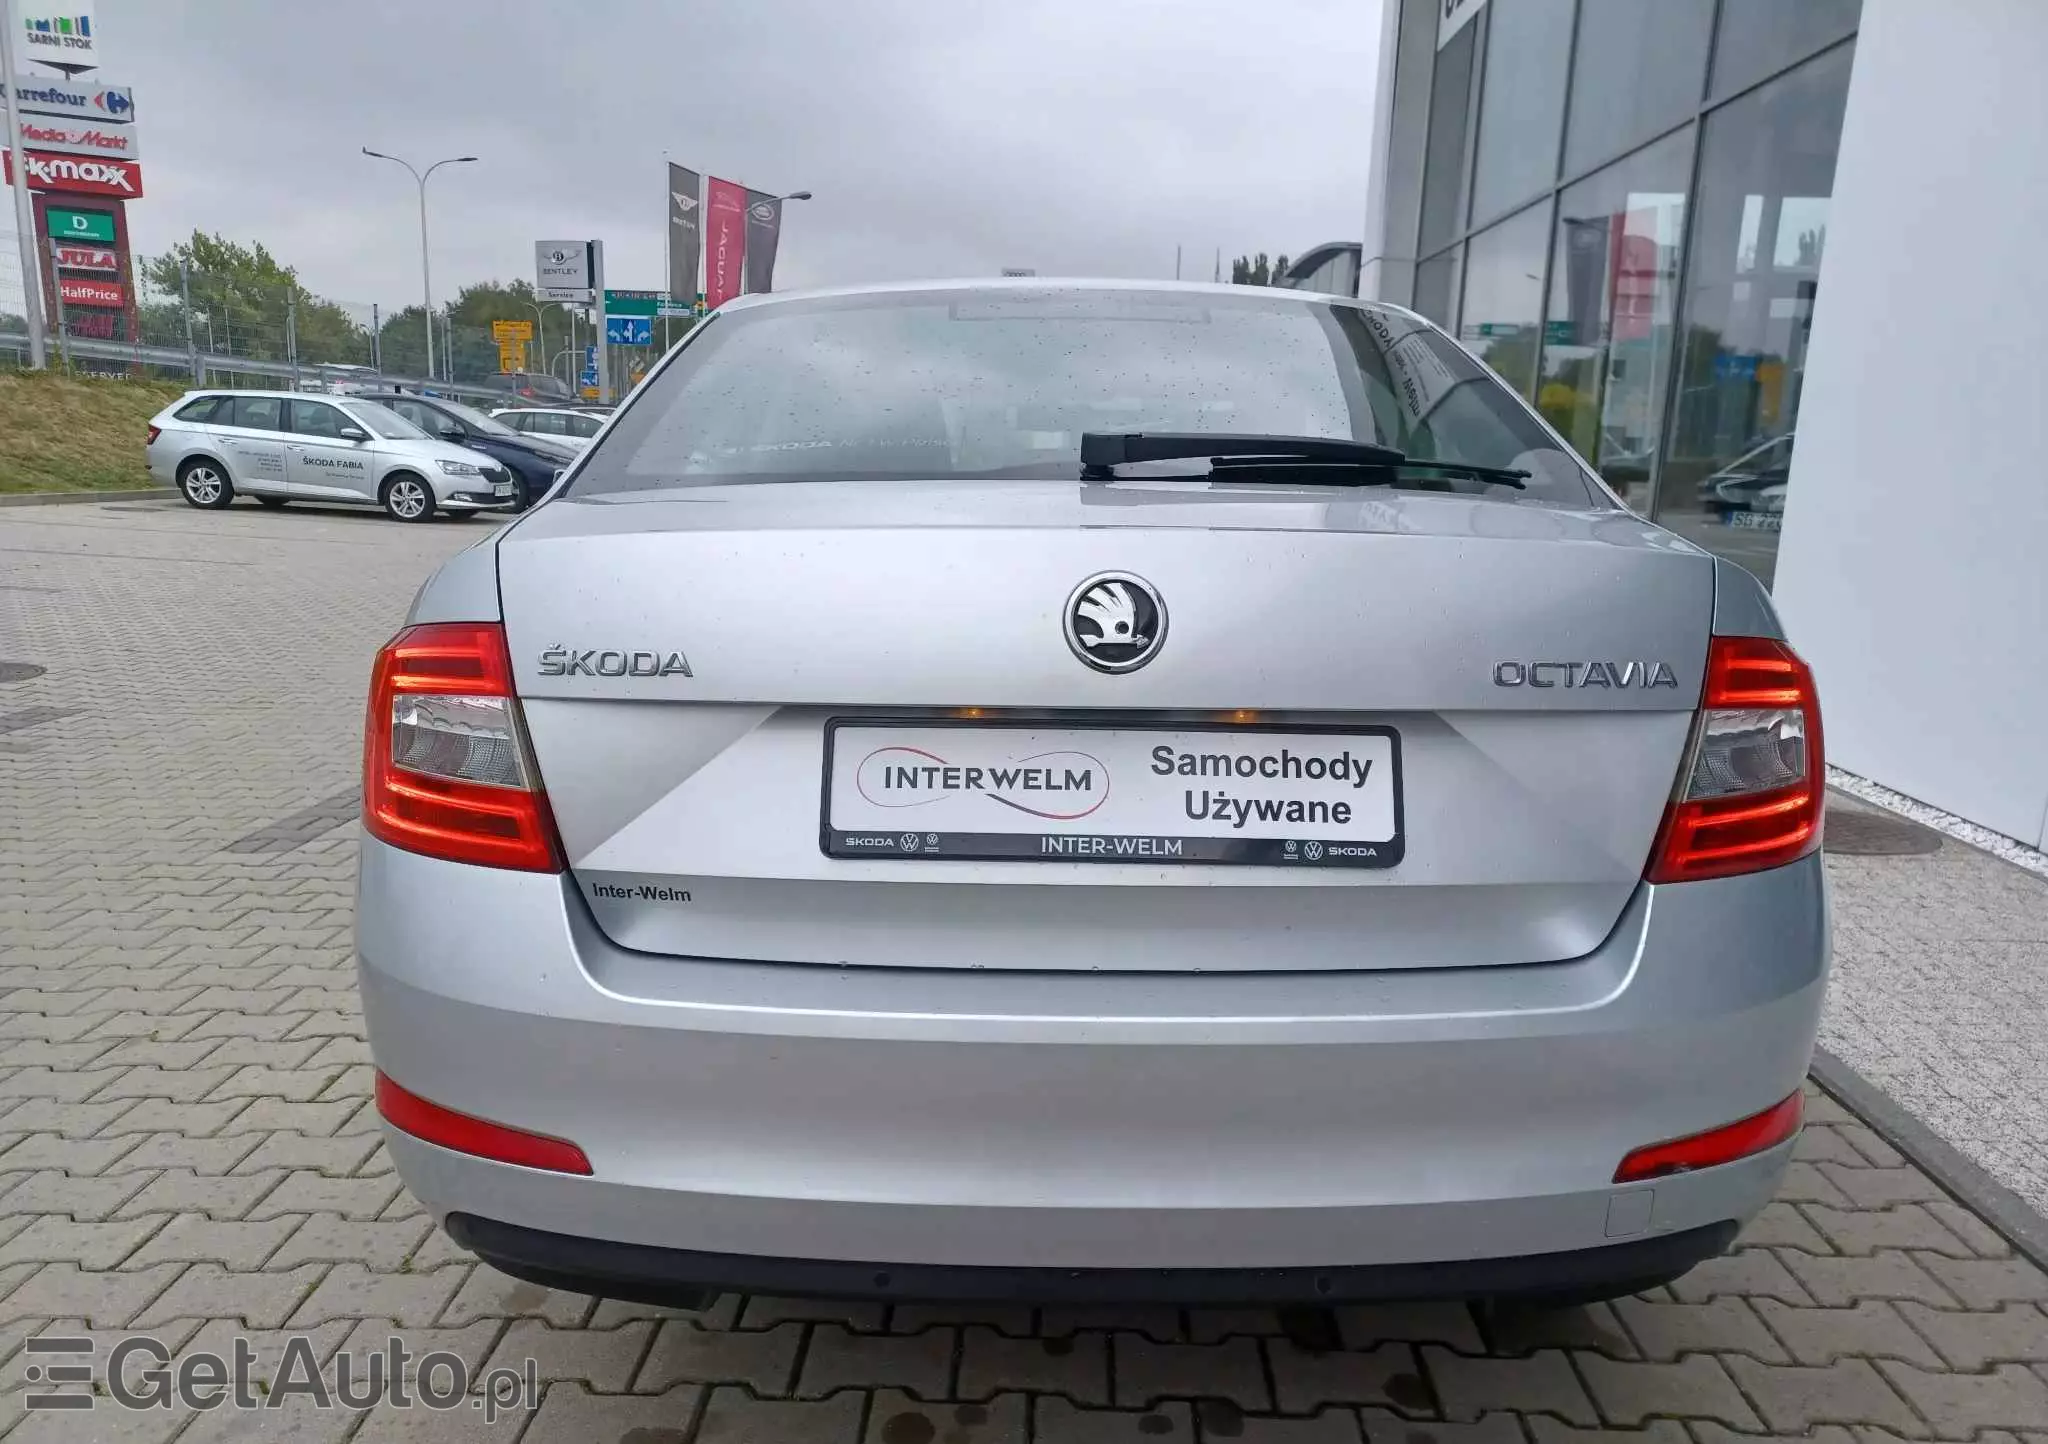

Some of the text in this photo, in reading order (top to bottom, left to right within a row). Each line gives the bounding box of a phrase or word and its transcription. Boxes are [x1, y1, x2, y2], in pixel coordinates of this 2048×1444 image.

[27, 32, 92, 49] SARNI STOK
[60, 285, 118, 301] HalfPrice
[302, 455, 364, 470] ŠKODA FABIA
[537, 643, 694, 678] ŠKODA
[1492, 661, 1679, 689] OCTAVIA
[1150, 745, 1374, 788] Samochody
[1184, 790, 1352, 829] Używane
[845, 837, 895, 847] SKODA
[1040, 835, 1183, 857] INTER-WELM
[1328, 847, 1378, 857] SKODA
[592, 882, 692, 902] Inter-Welm
